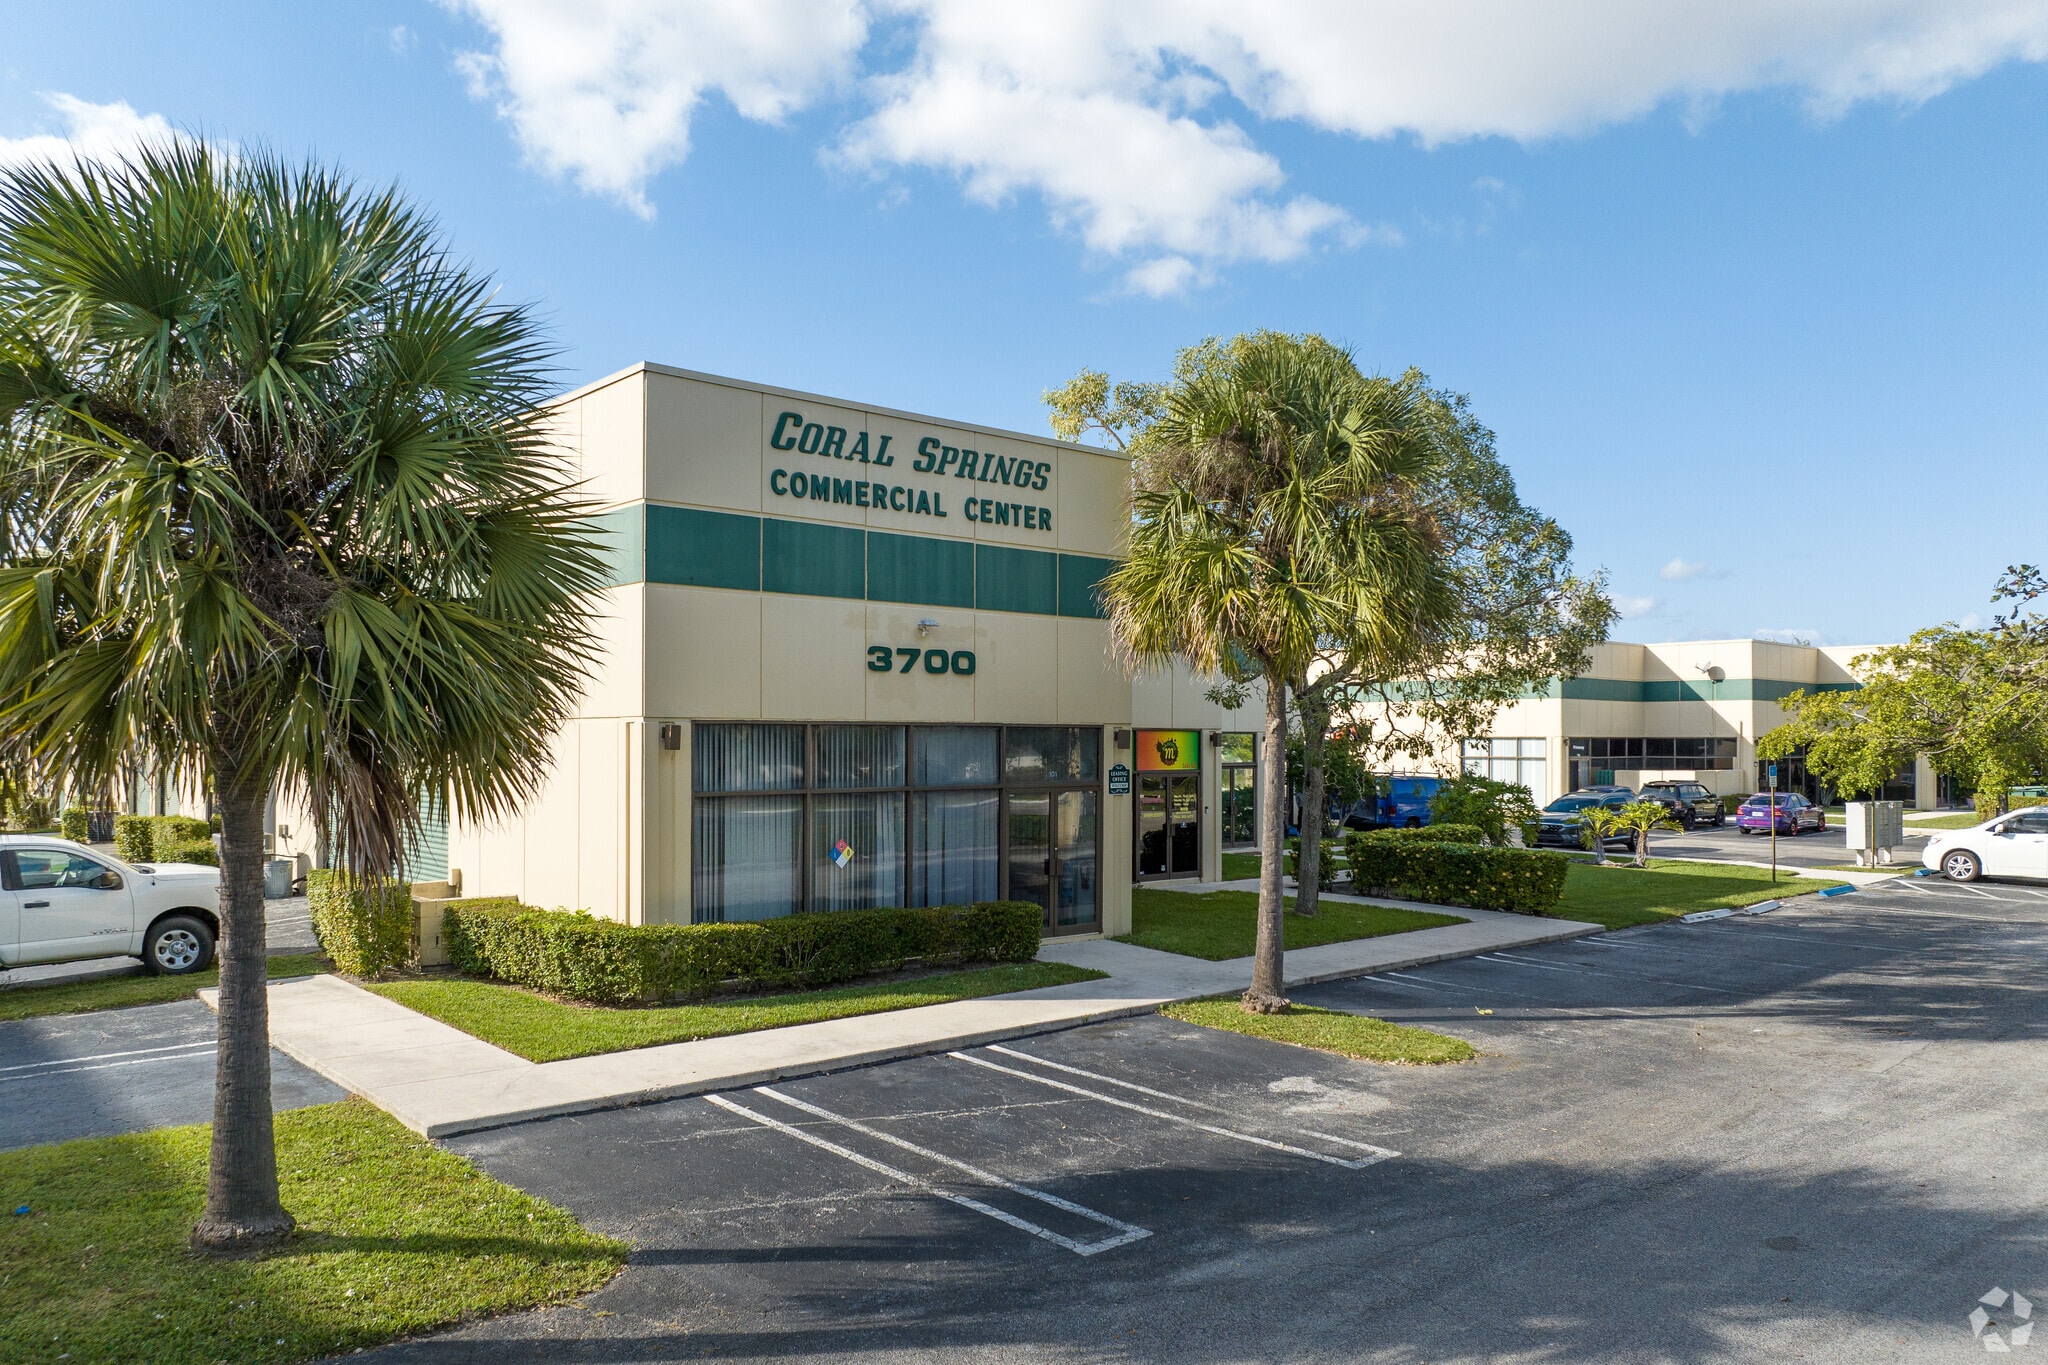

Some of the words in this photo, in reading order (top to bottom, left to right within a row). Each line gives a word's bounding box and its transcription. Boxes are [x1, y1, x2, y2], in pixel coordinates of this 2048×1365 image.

[771, 412, 894, 466] CORAL
[913, 437, 1051, 490] SPRINGS
[771, 469, 947, 517] COMMERCIAL
[965, 497, 1052, 531] CENTER
[867, 646, 976, 675] 3700
